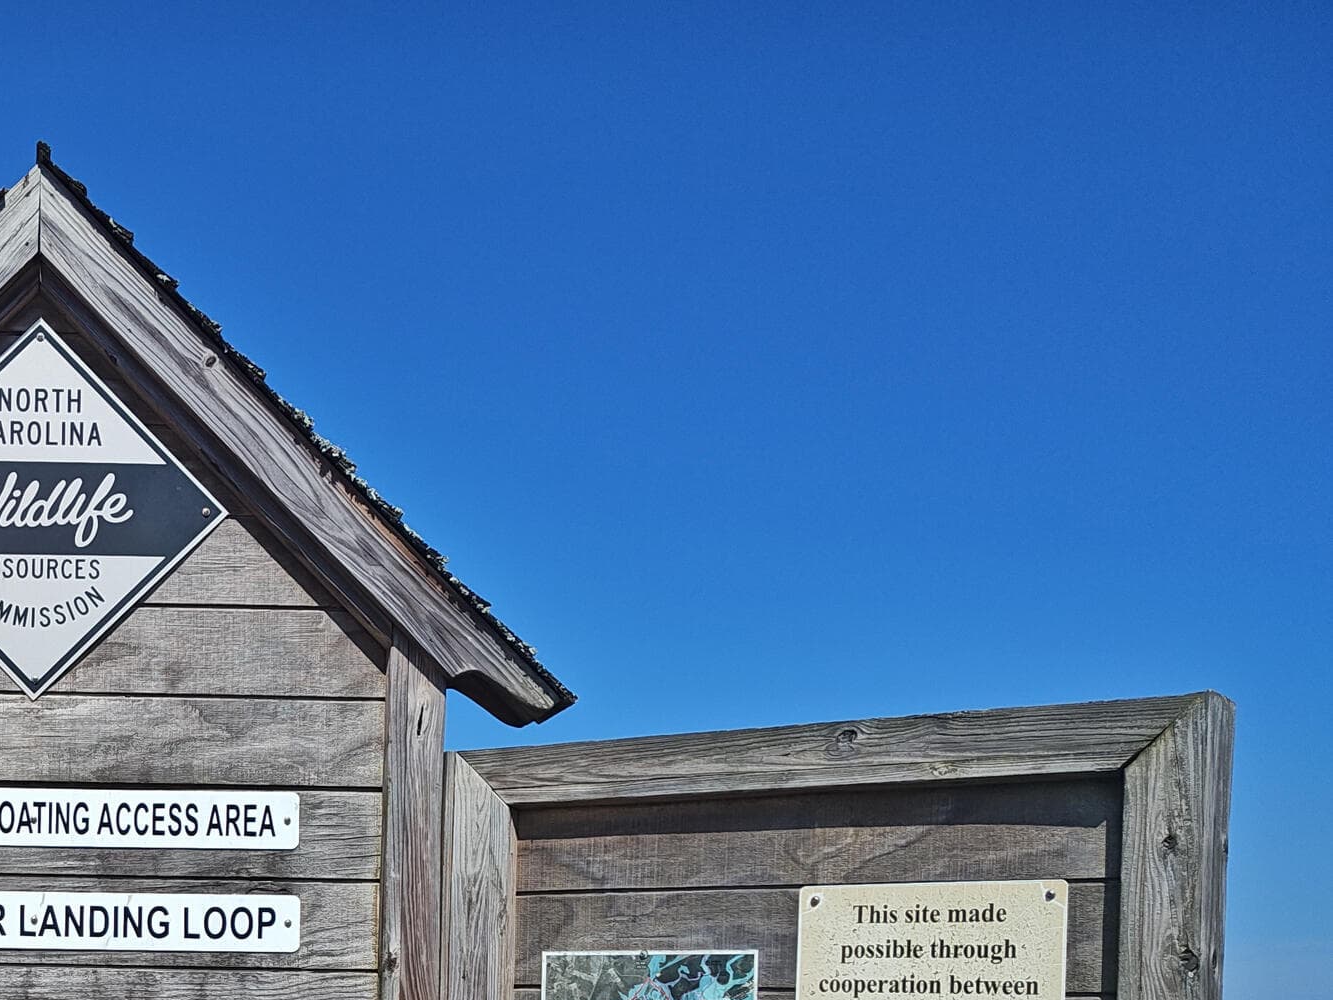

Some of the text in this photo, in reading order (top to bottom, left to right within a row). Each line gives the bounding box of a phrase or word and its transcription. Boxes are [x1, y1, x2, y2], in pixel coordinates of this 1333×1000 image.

[97, 803, 198, 836] ACCESS
[207, 804, 275, 837] AREA
[20, 905, 170, 939] LANDING
[184, 907, 276, 939] LOOP
[853, 903, 1006, 923] This site made
[841, 939, 1016, 964] possible through
[819, 975, 1038, 998] cooperation between
